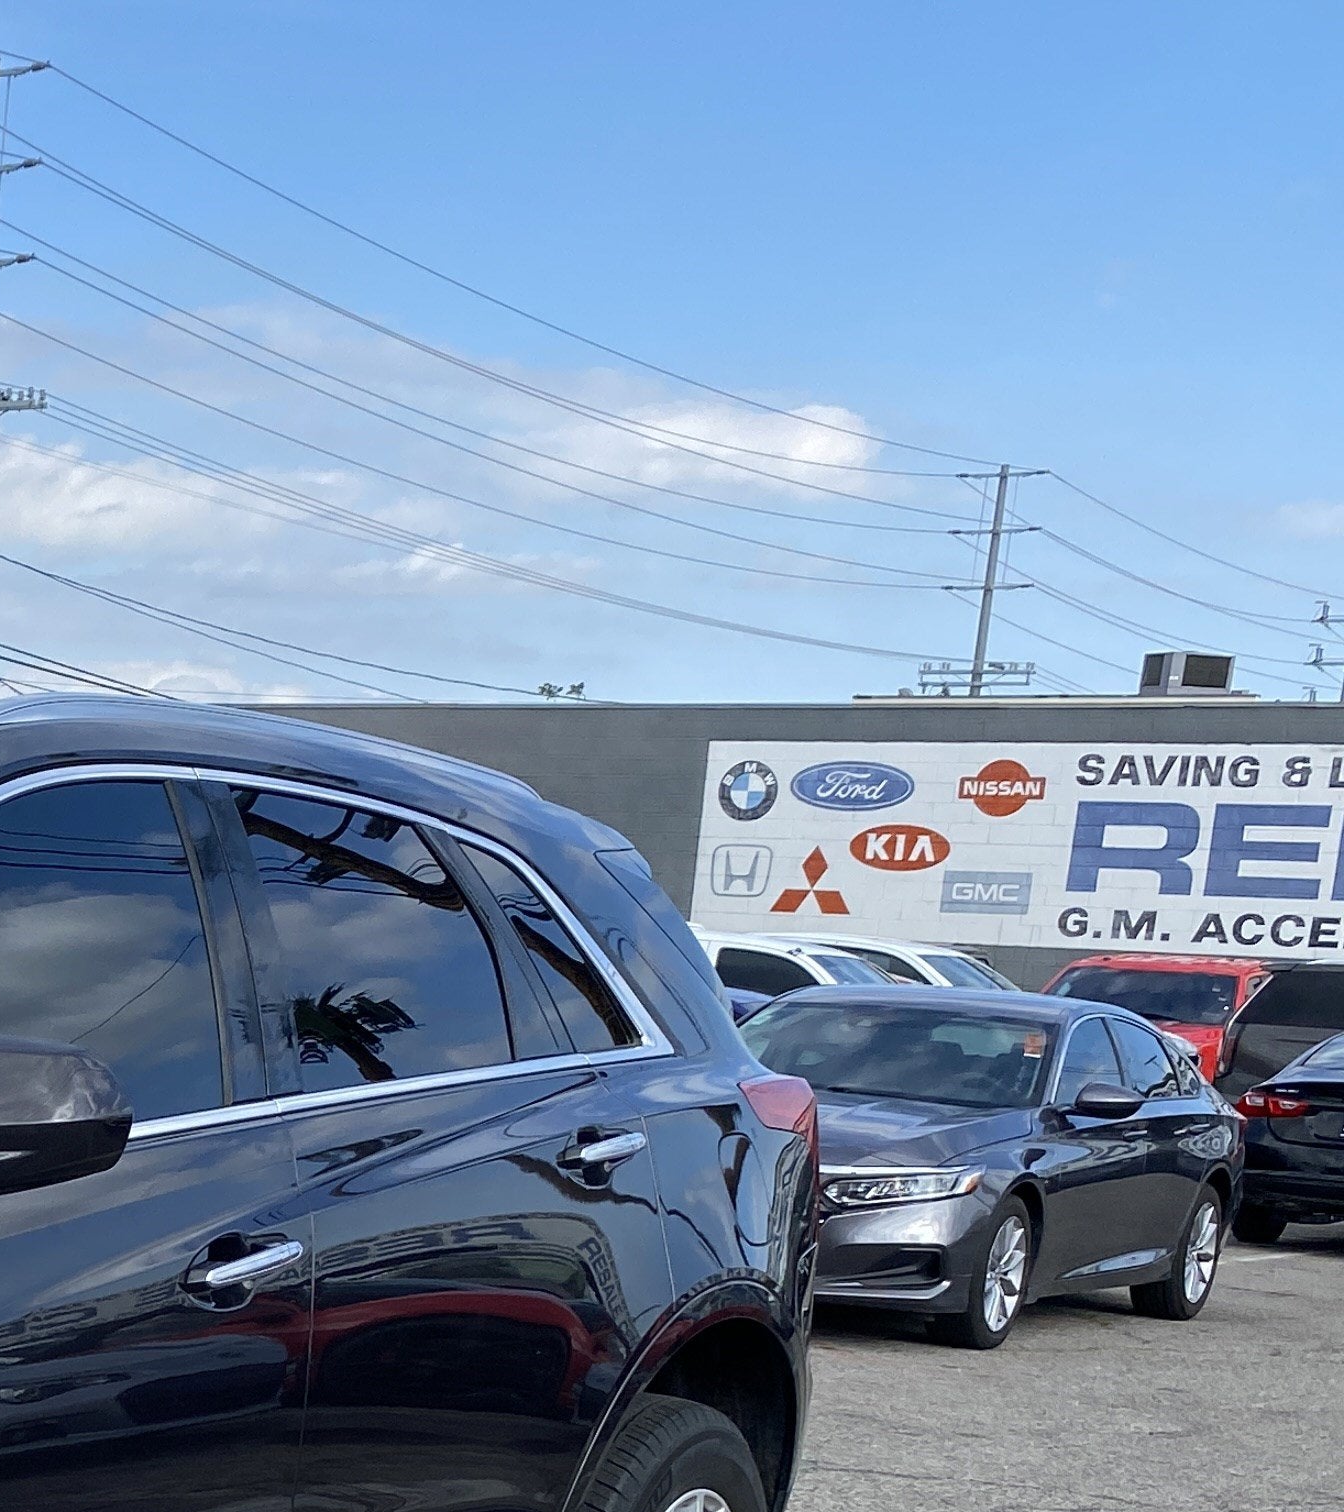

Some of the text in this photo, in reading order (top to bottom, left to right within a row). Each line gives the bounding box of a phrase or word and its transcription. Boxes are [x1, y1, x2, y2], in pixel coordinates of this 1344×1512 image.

[722, 762, 777, 786] BMW
[816, 770, 889, 801] Ford
[1076, 754, 1260, 788] SAVING
[1281, 756, 1312, 788] &
[962, 780, 1041, 797] NISSAN
[864, 832, 935, 863] KIA
[1065, 801, 1344, 901] RE
[951, 882, 1021, 902] GMC
[1058, 907, 1344, 949] G.M. ACCE
